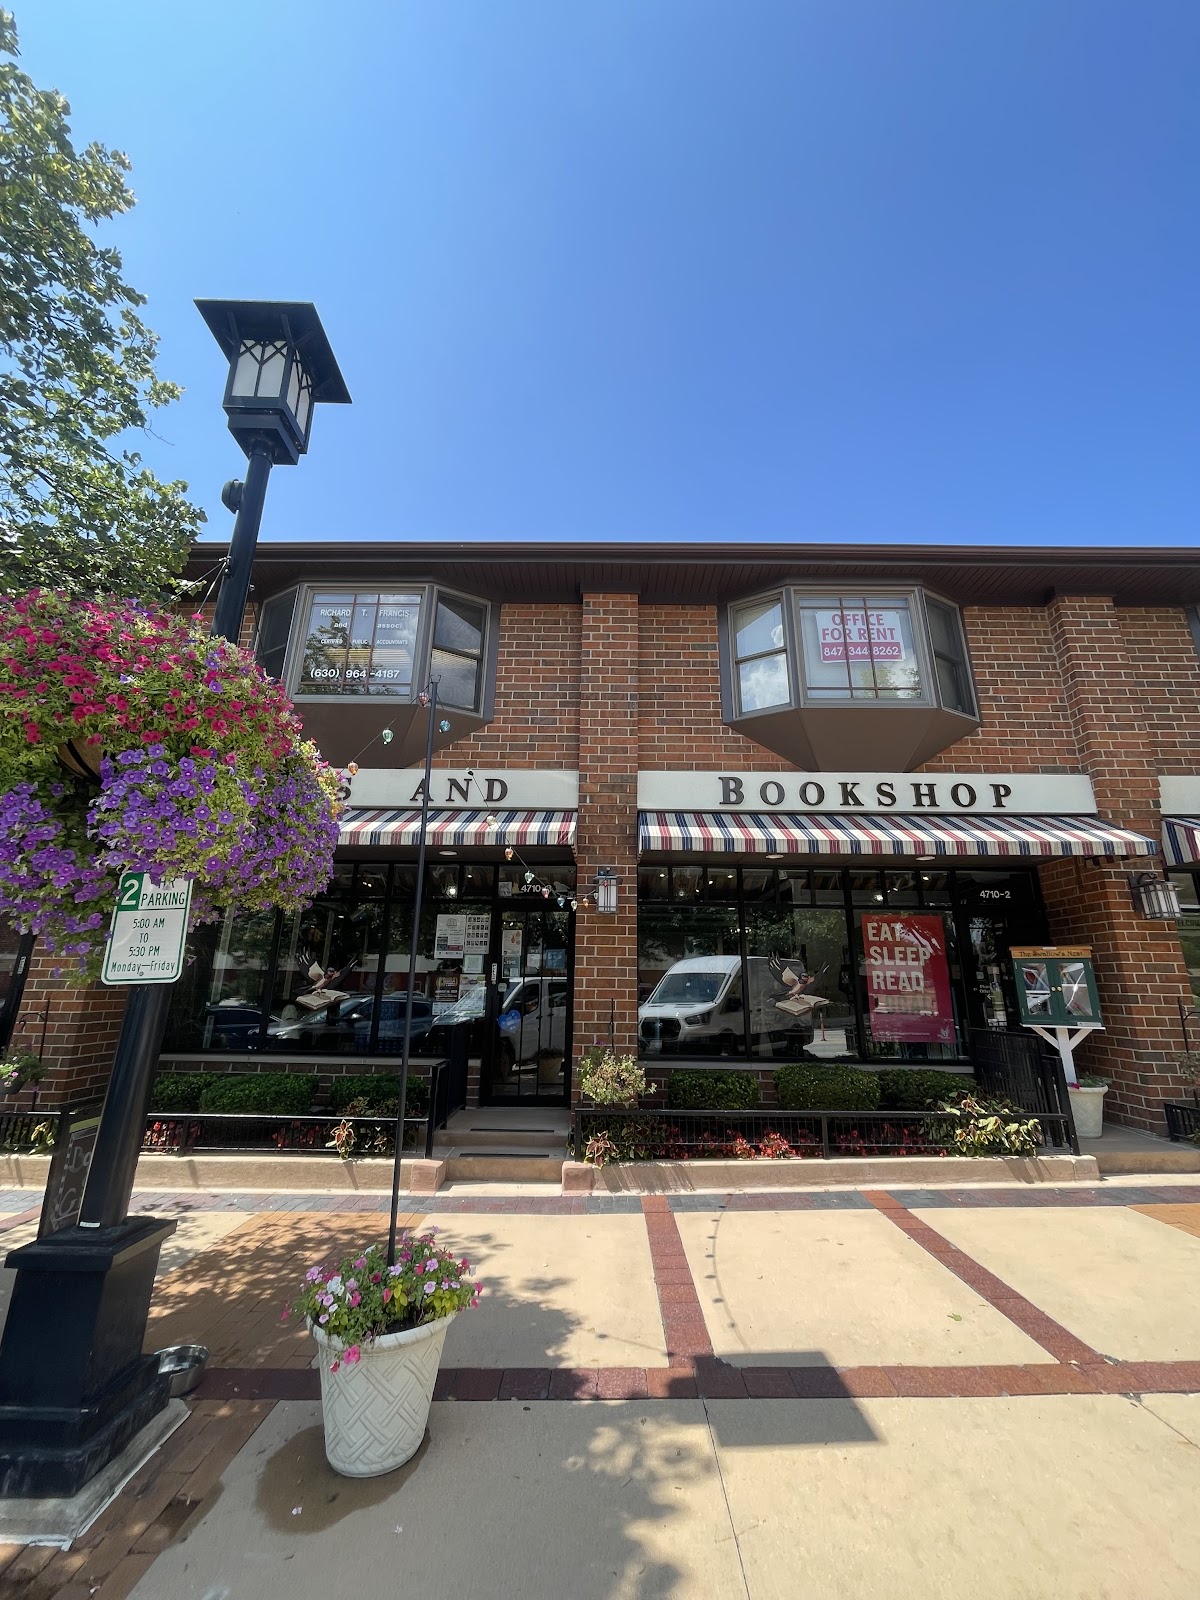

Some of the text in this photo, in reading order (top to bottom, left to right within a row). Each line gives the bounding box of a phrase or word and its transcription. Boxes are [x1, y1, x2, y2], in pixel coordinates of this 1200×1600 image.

[320, 609, 351, 617] RICHARD
[361, 609, 368, 617] T.
[832, 613, 885, 626] OFFICE
[821, 627, 896, 641] FOR RENT
[310, 668, 340, 679] (630)
[410, 776, 1012, 808] AND BOOKSHOP
[120, 879, 140, 906] 2
[140, 891, 186, 907] PARKING
[980, 890, 1011, 899] 4710-2
[132, 918, 165, 929] 5:00 AM
[138, 932, 149, 943] TO
[867, 922, 902, 942] EAT
[128, 945, 161, 958] 5:30 PM
[869, 945, 931, 967] SLEEP
[872, 970, 925, 992] READ
